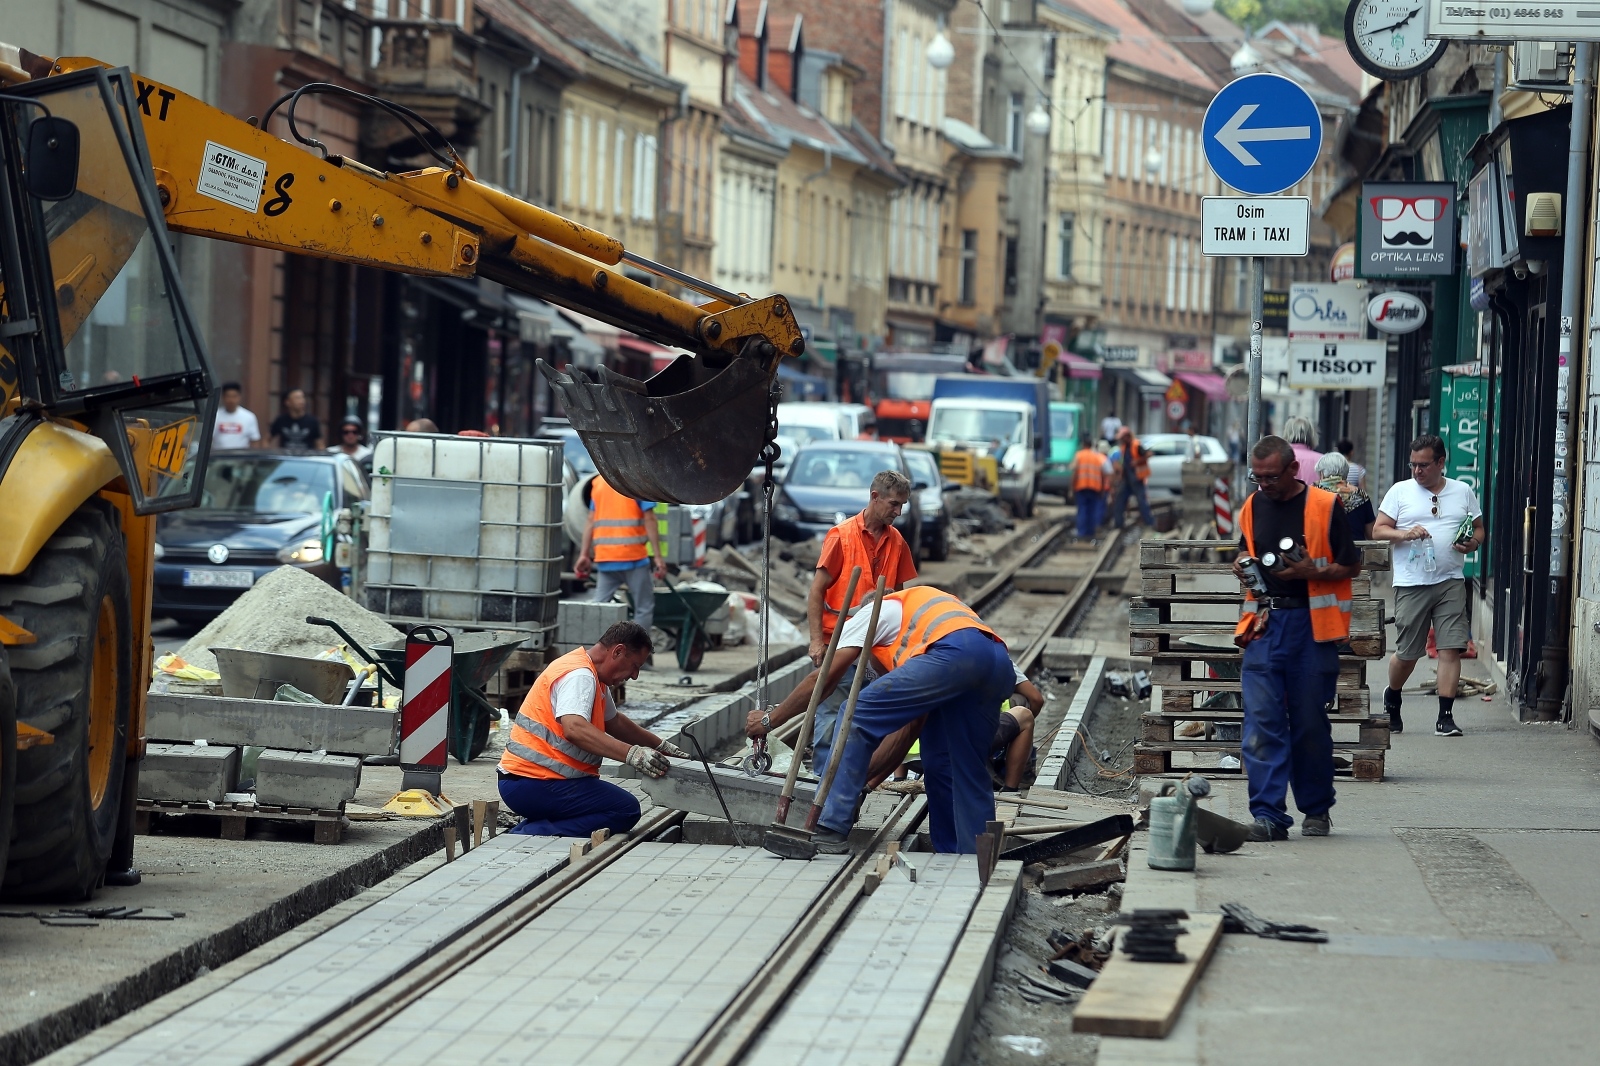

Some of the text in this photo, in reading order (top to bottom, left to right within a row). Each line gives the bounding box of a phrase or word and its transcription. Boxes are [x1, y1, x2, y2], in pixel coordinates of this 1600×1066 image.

[1369, 5, 1378, 15] 10
[1489, 8, 1511, 19] (01)
[1513, 8, 1541, 18] 4846
[1543, 8, 1564, 19] 843
[1362, 20, 1368, 29] 9
[1367, 37, 1373, 46] 8
[1378, 48, 1384, 58] 7
[1394, 53, 1400, 62] 6
[1409, 49, 1417, 58] 5
[1237, 204, 1265, 219] Osim
[1214, 227, 1290, 241] TRAM i TAXI
[1370, 252, 1445, 263] OPTIKA LENS
[1292, 293, 1348, 321] Orbis
[1297, 359, 1377, 374] TISSOT
